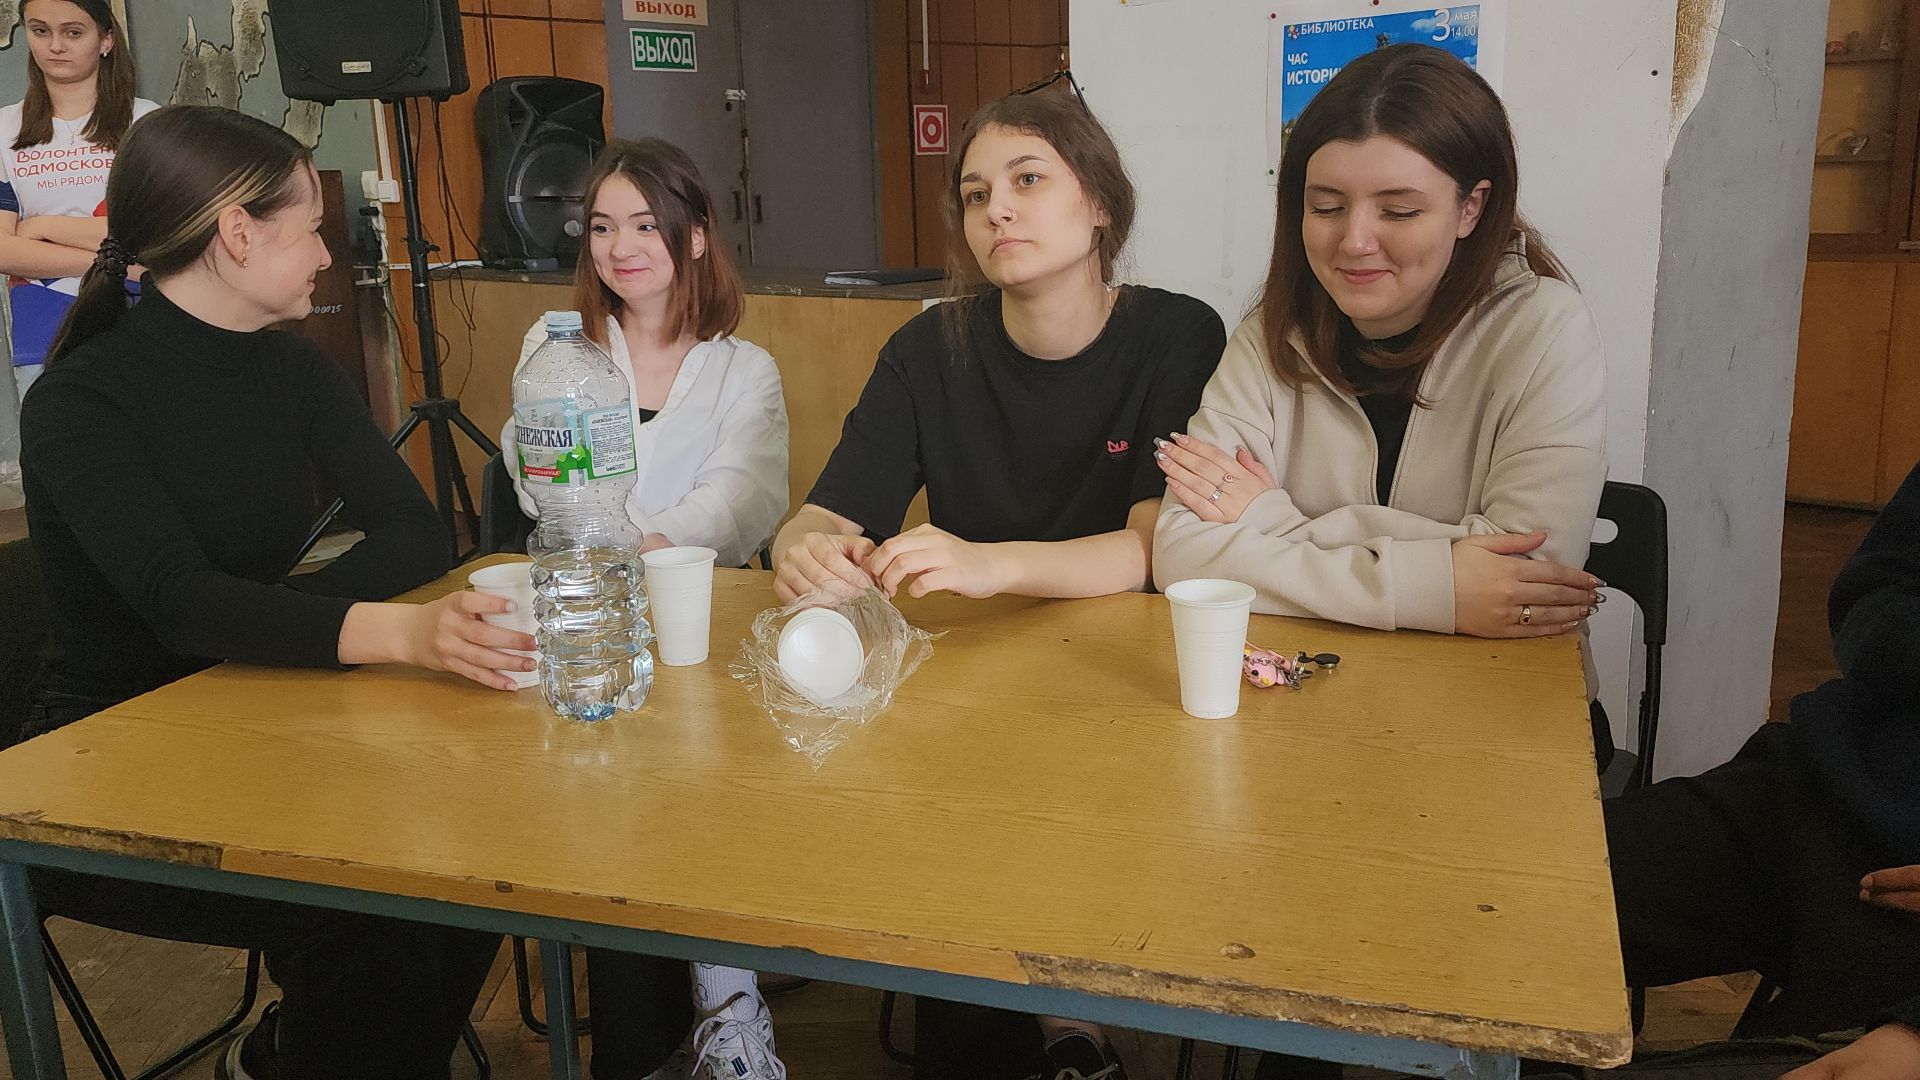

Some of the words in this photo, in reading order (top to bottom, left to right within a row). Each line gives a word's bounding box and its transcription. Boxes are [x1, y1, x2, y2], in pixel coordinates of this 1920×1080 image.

[635, 0, 697, 18] ВЫХОД
[1301, 17, 1375, 35] БИБЛИОТЕКА
[1432, 8, 1451, 42] 3
[1454, 11, 1477, 22] мая
[1450, 25, 1476, 38] 14.00
[634, 35, 693, 65] ВЫХОД
[1287, 52, 1309, 65] ЧАС
[37, 178, 57, 190] МЫ
[60, 175, 104, 188] РЯДОМ
